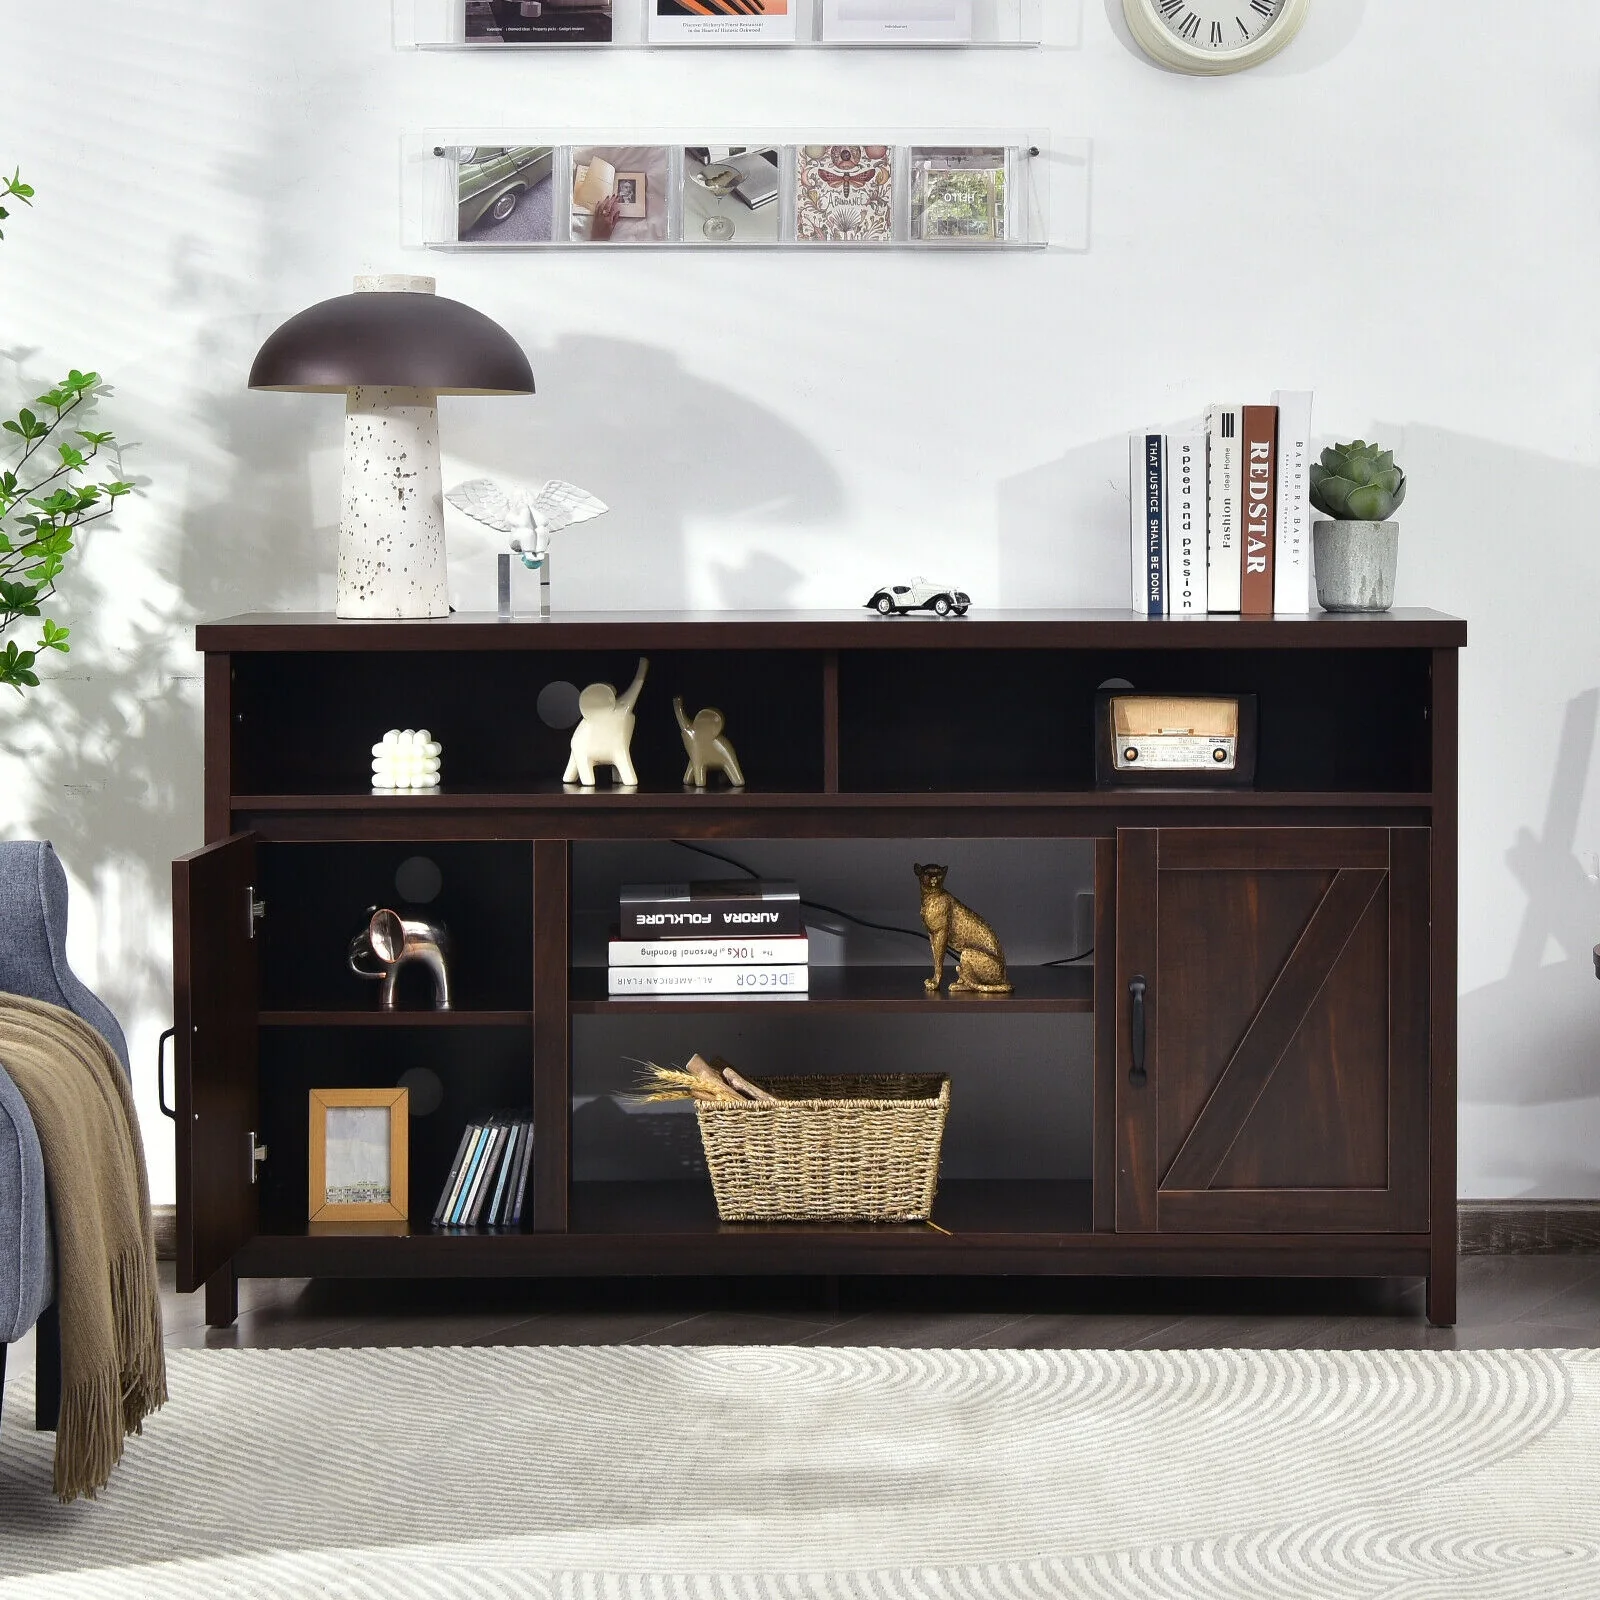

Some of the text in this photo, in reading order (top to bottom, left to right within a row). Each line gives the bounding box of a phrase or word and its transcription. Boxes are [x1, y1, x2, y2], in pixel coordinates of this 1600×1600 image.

[1247, 440, 1270, 574] REDSTAR
[1150, 442, 1159, 602] THAT JUSTICE SHALL BE DONE
[1182, 445, 1191, 607] speed and passion
[1222, 498, 1231, 549] Fashion
[636, 912, 779, 924] AURORA FOLKLORE
[641, 948, 676, 957] Branding
[681, 949, 718, 957] Personal
[728, 948, 754, 958] 10Ks
[736, 974, 788, 986] DECOR
